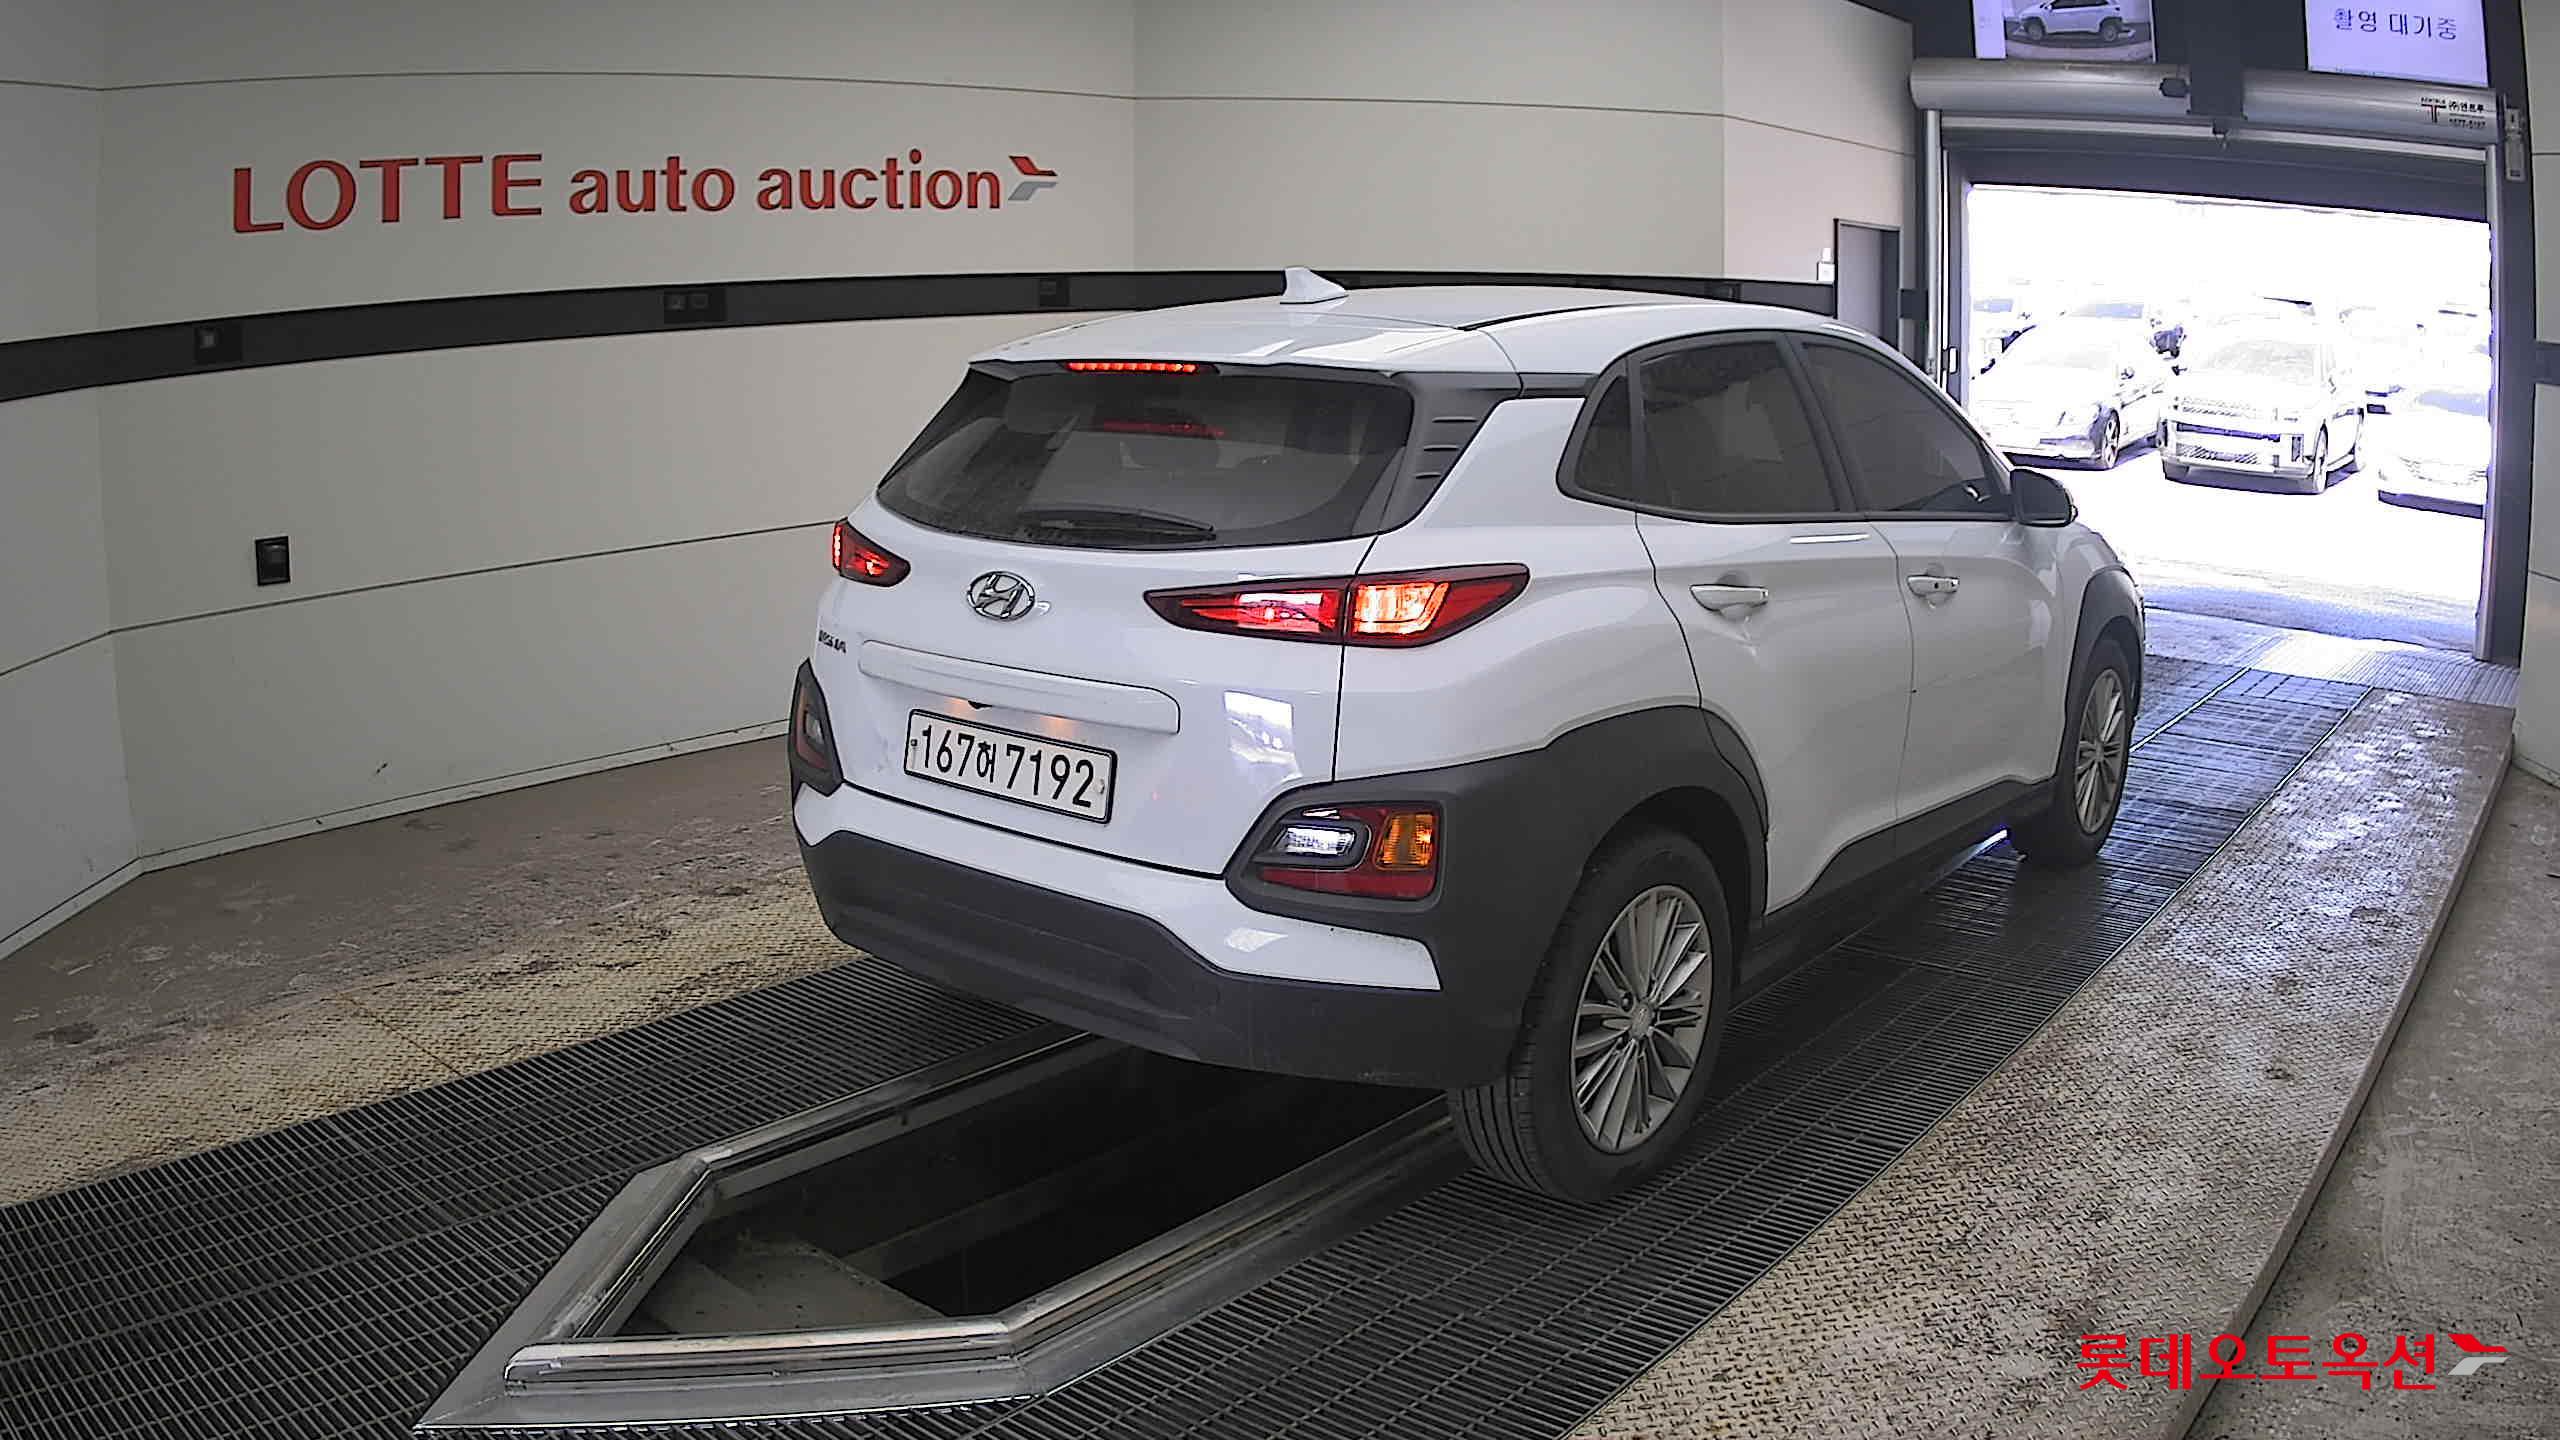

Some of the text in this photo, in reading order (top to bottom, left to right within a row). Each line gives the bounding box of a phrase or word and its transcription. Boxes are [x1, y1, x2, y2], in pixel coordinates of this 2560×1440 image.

[2389, 14, 2457, 40] 대기중
[233, 149, 1000, 233] LOTTE auto auction
